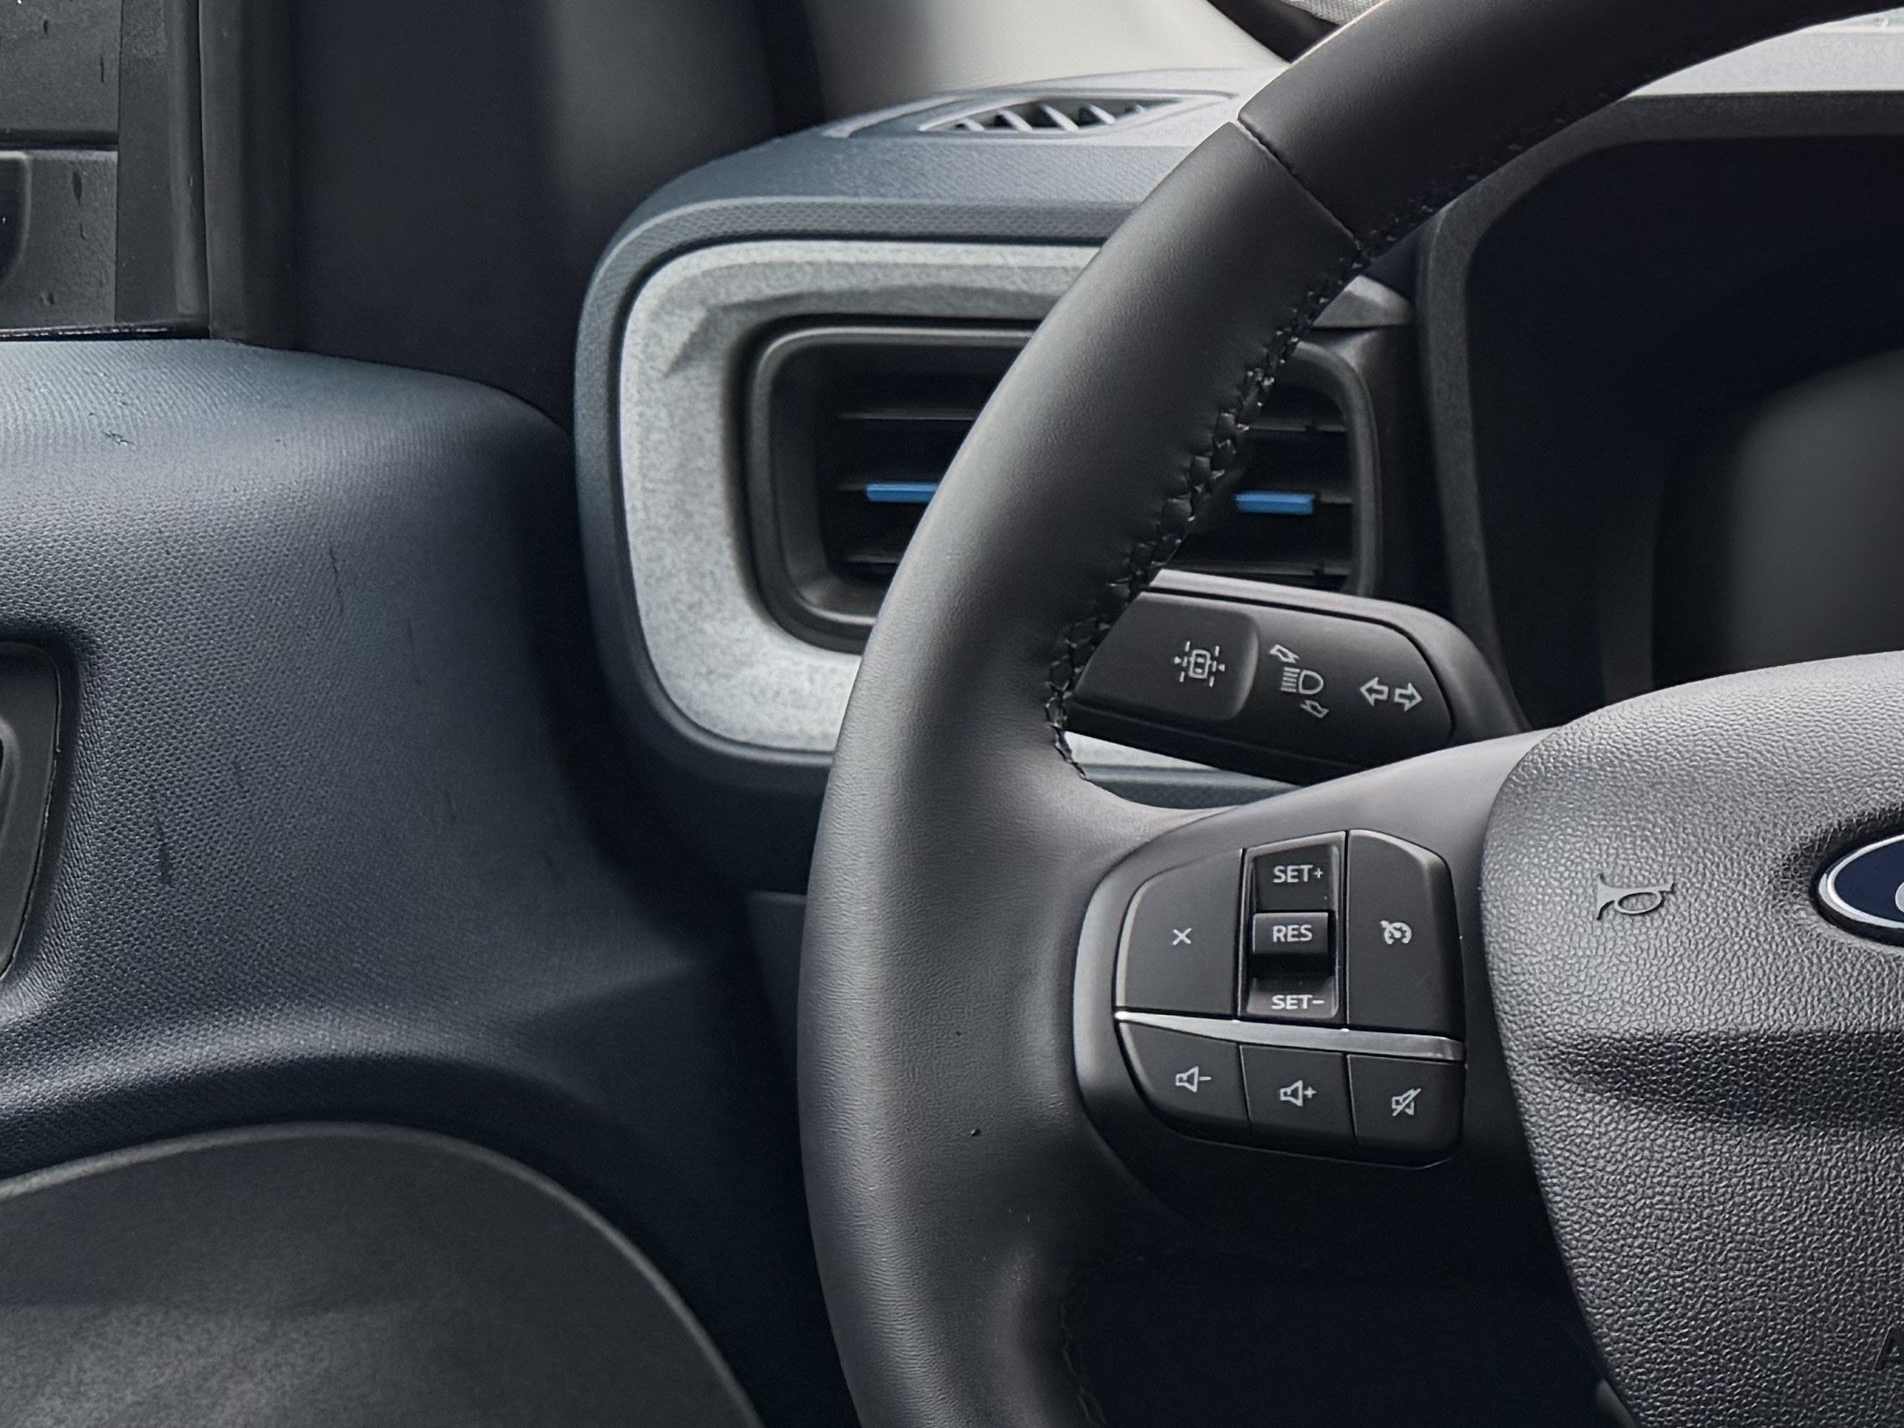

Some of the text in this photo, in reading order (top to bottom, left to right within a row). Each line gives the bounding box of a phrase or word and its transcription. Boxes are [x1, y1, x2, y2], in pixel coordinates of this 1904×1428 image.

[1272, 864, 1324, 884] SET+
[1272, 924, 1314, 943] RES
[1271, 994, 1325, 1010] SET-
